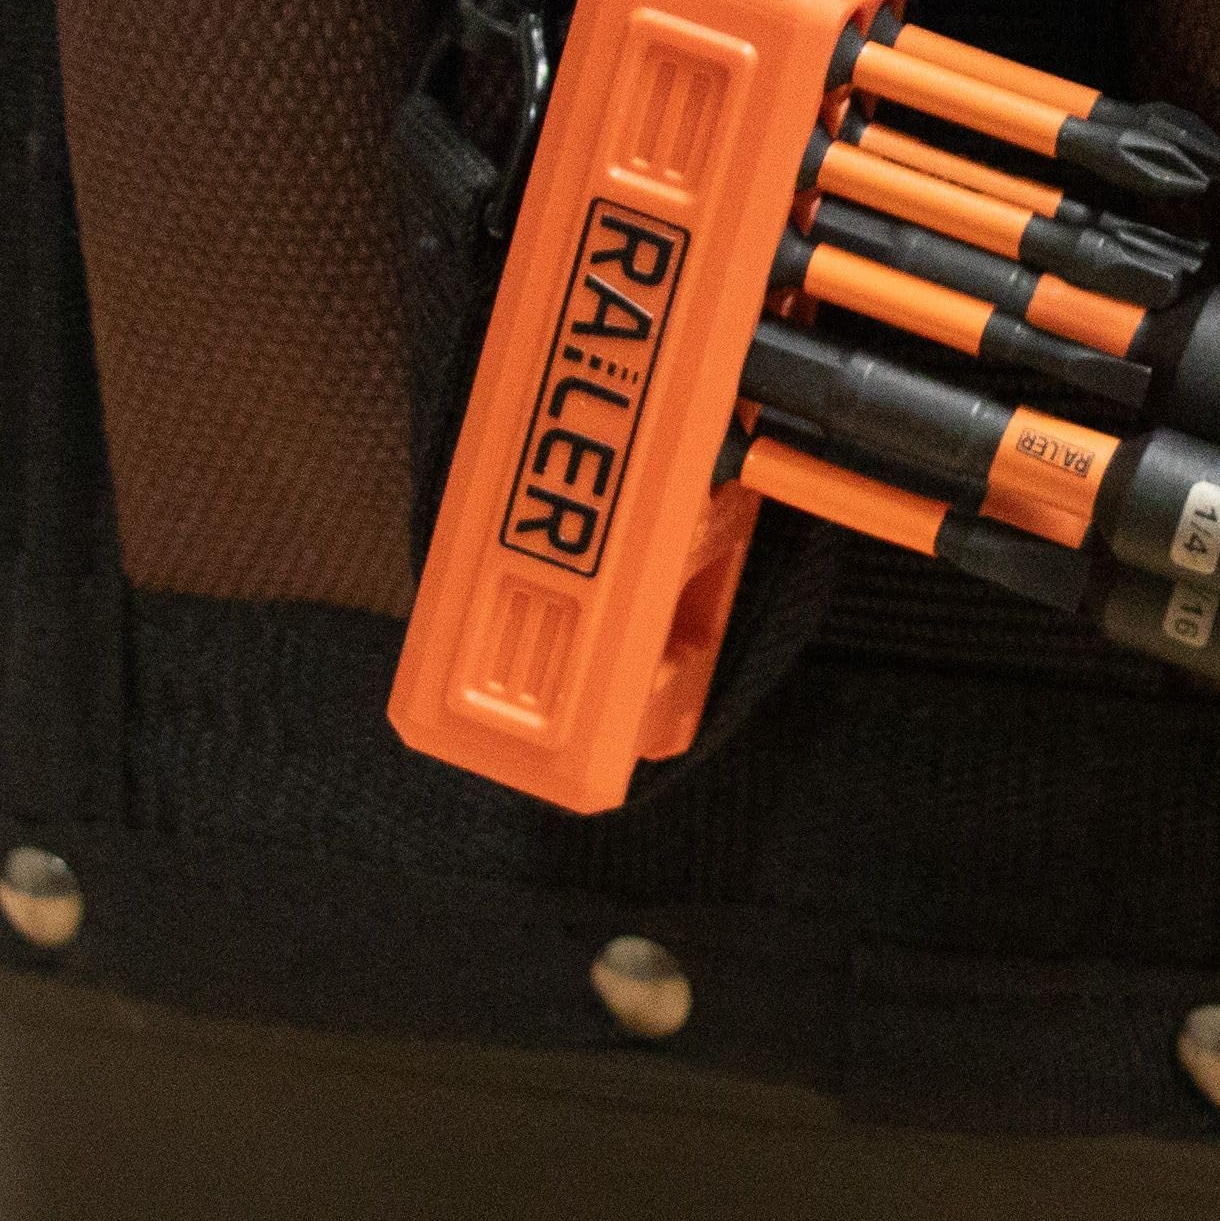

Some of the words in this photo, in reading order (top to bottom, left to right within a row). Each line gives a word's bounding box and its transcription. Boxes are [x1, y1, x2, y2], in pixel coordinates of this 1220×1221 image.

[515, 214, 674, 556] RAILER
[1018, 430, 1093, 477] RAILER
[1183, 505, 1218, 555] 1/4
